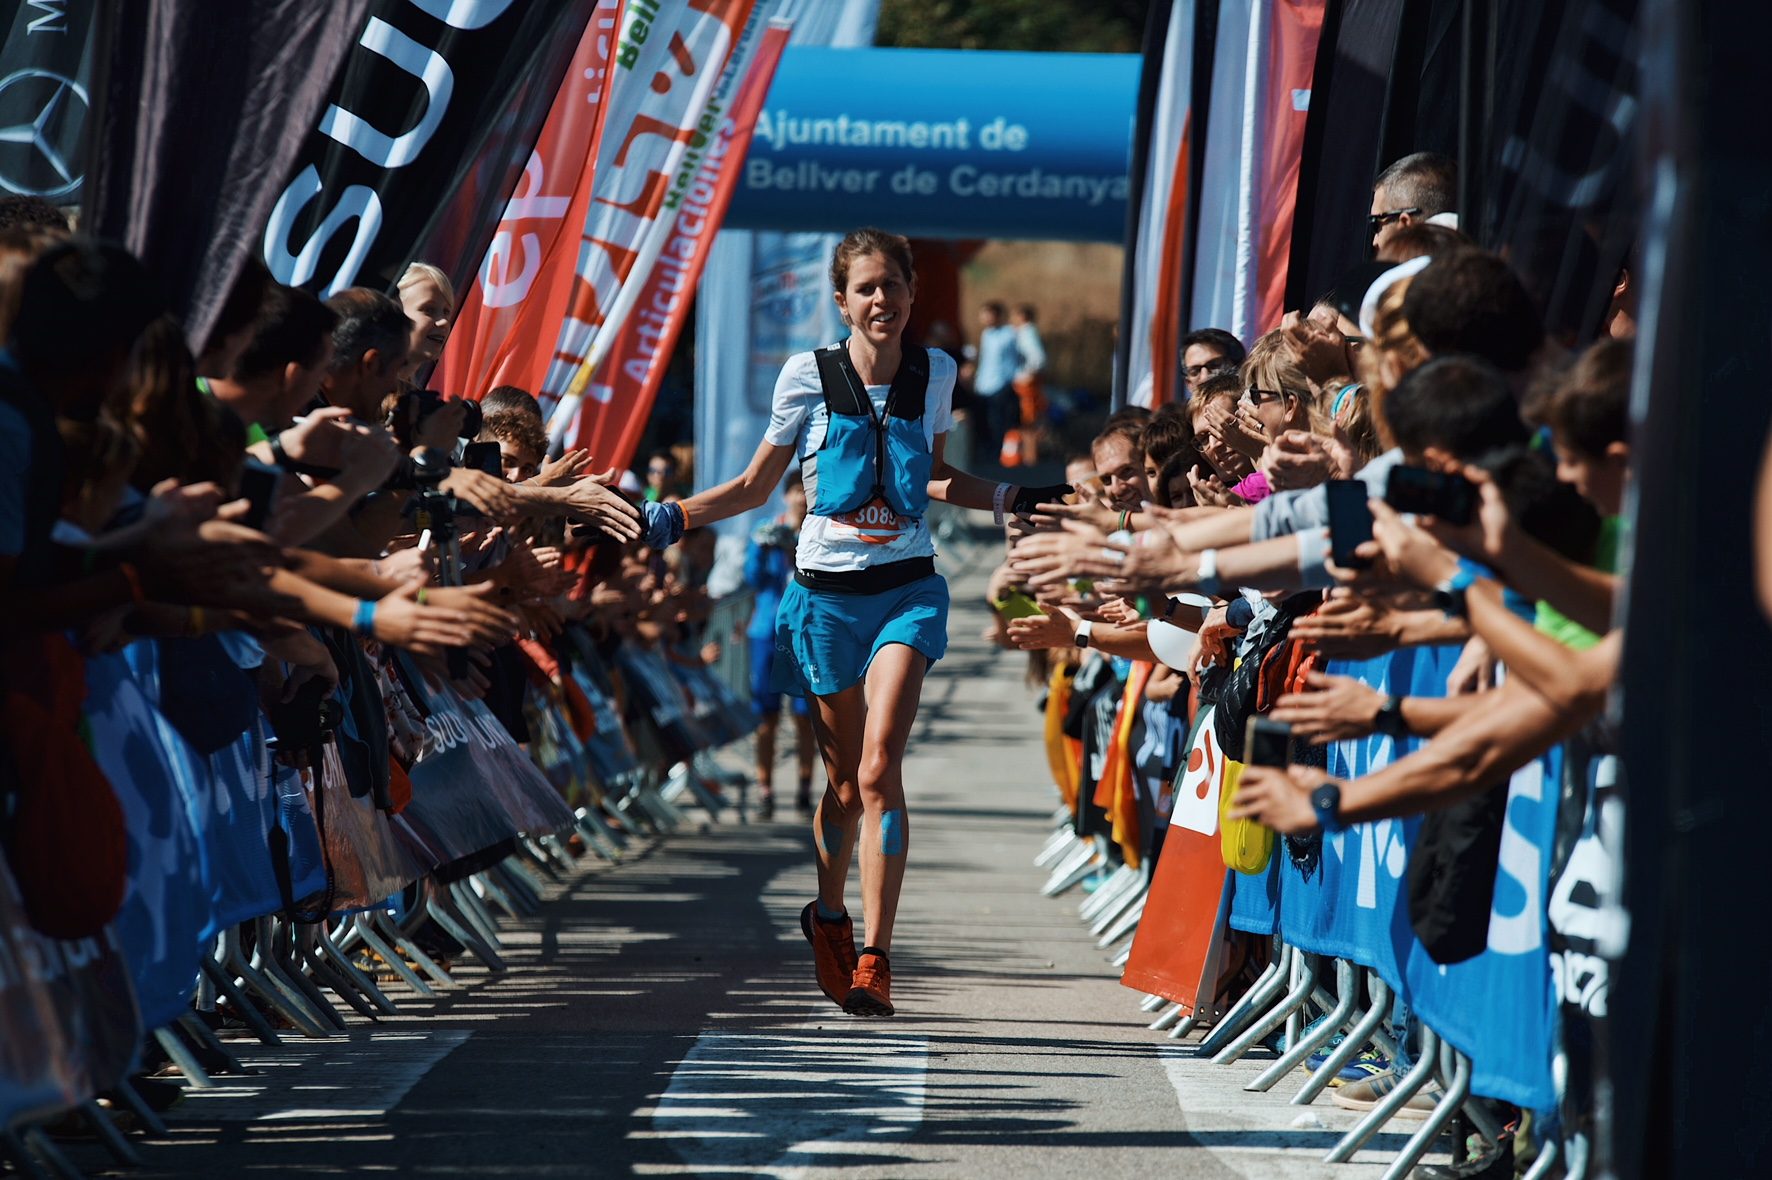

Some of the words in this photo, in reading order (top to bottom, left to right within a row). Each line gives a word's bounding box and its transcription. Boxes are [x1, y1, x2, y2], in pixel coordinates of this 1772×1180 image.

[753, 110, 971, 152] Ajuntament
[979, 115, 1030, 152] de
[744, 157, 880, 192] Bellver
[890, 164, 938, 195] de
[948, 164, 1130, 206] Cerdanya
[623, 117, 737, 386] Articulaciones
